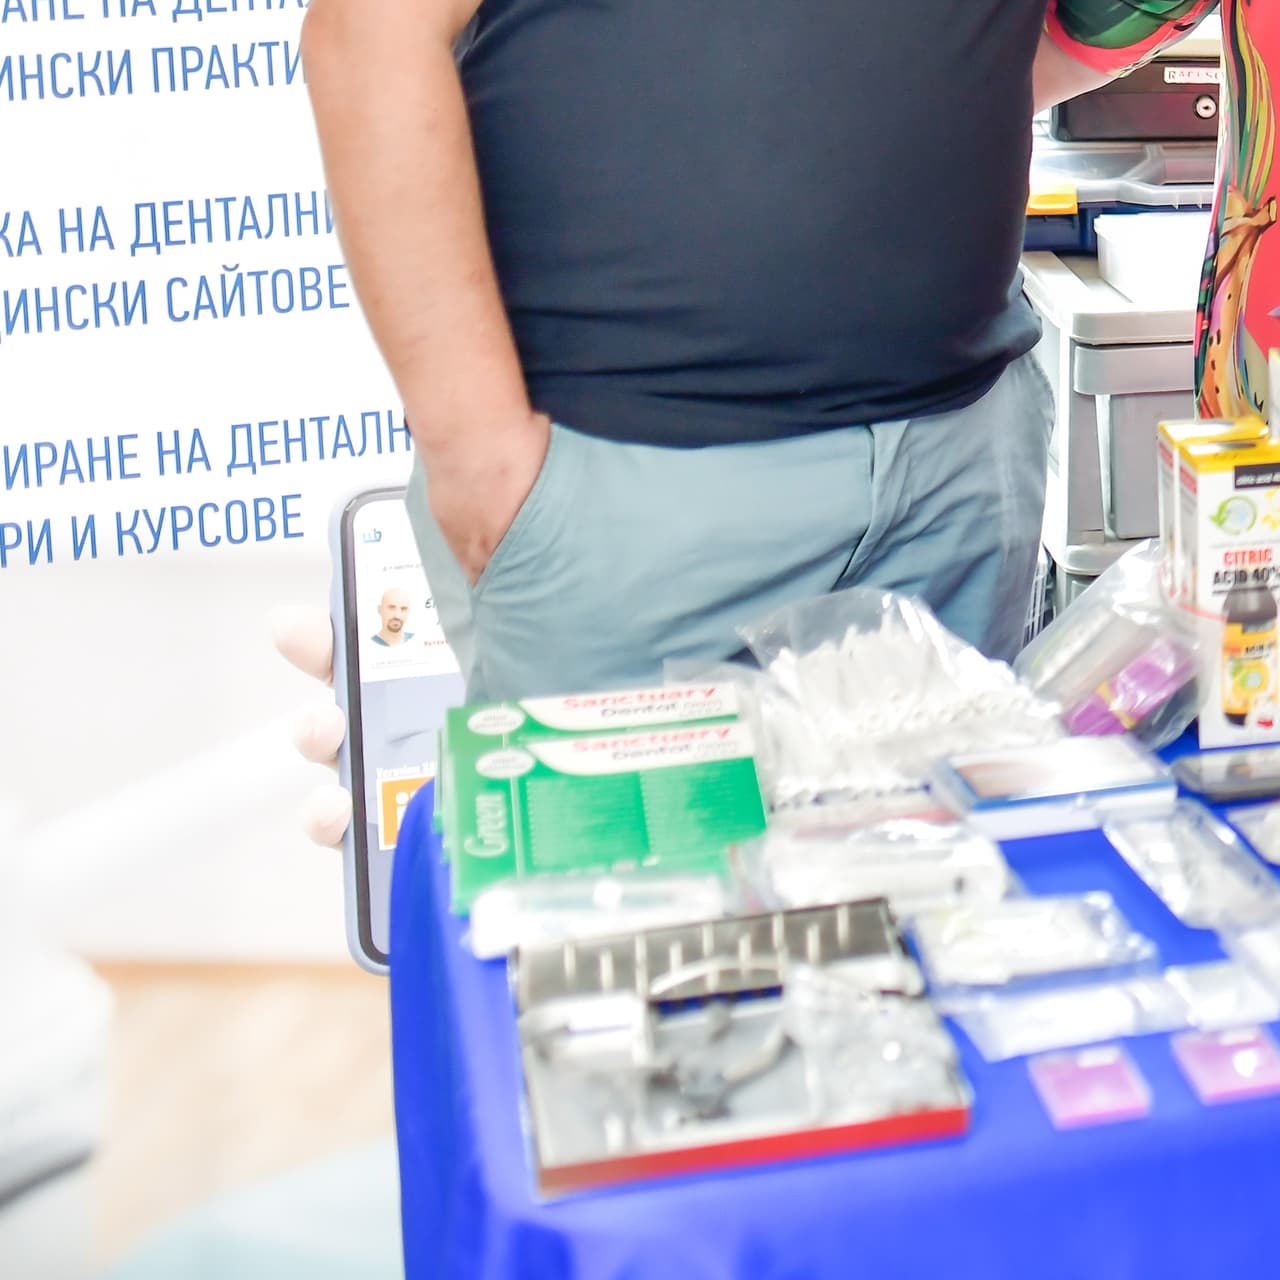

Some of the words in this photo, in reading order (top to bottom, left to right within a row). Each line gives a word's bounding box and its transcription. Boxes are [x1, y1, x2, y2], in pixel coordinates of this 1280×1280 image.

[58, 206, 115, 253] НА
[166, 264, 351, 323] САЙТОВЕ
[3, 433, 142, 492] ИРАНЕ
[156, 427, 212, 478] НА
[71, 513, 99, 563] И
[115, 493, 306, 556] КУРСОВЕ
[1223, 548, 1274, 566] CITRIC
[1213, 568, 1249, 586] ACID
[563, 687, 717, 712] Sanctuary
[600, 701, 678, 719] Dental
[572, 726, 731, 753] Sanctuary
